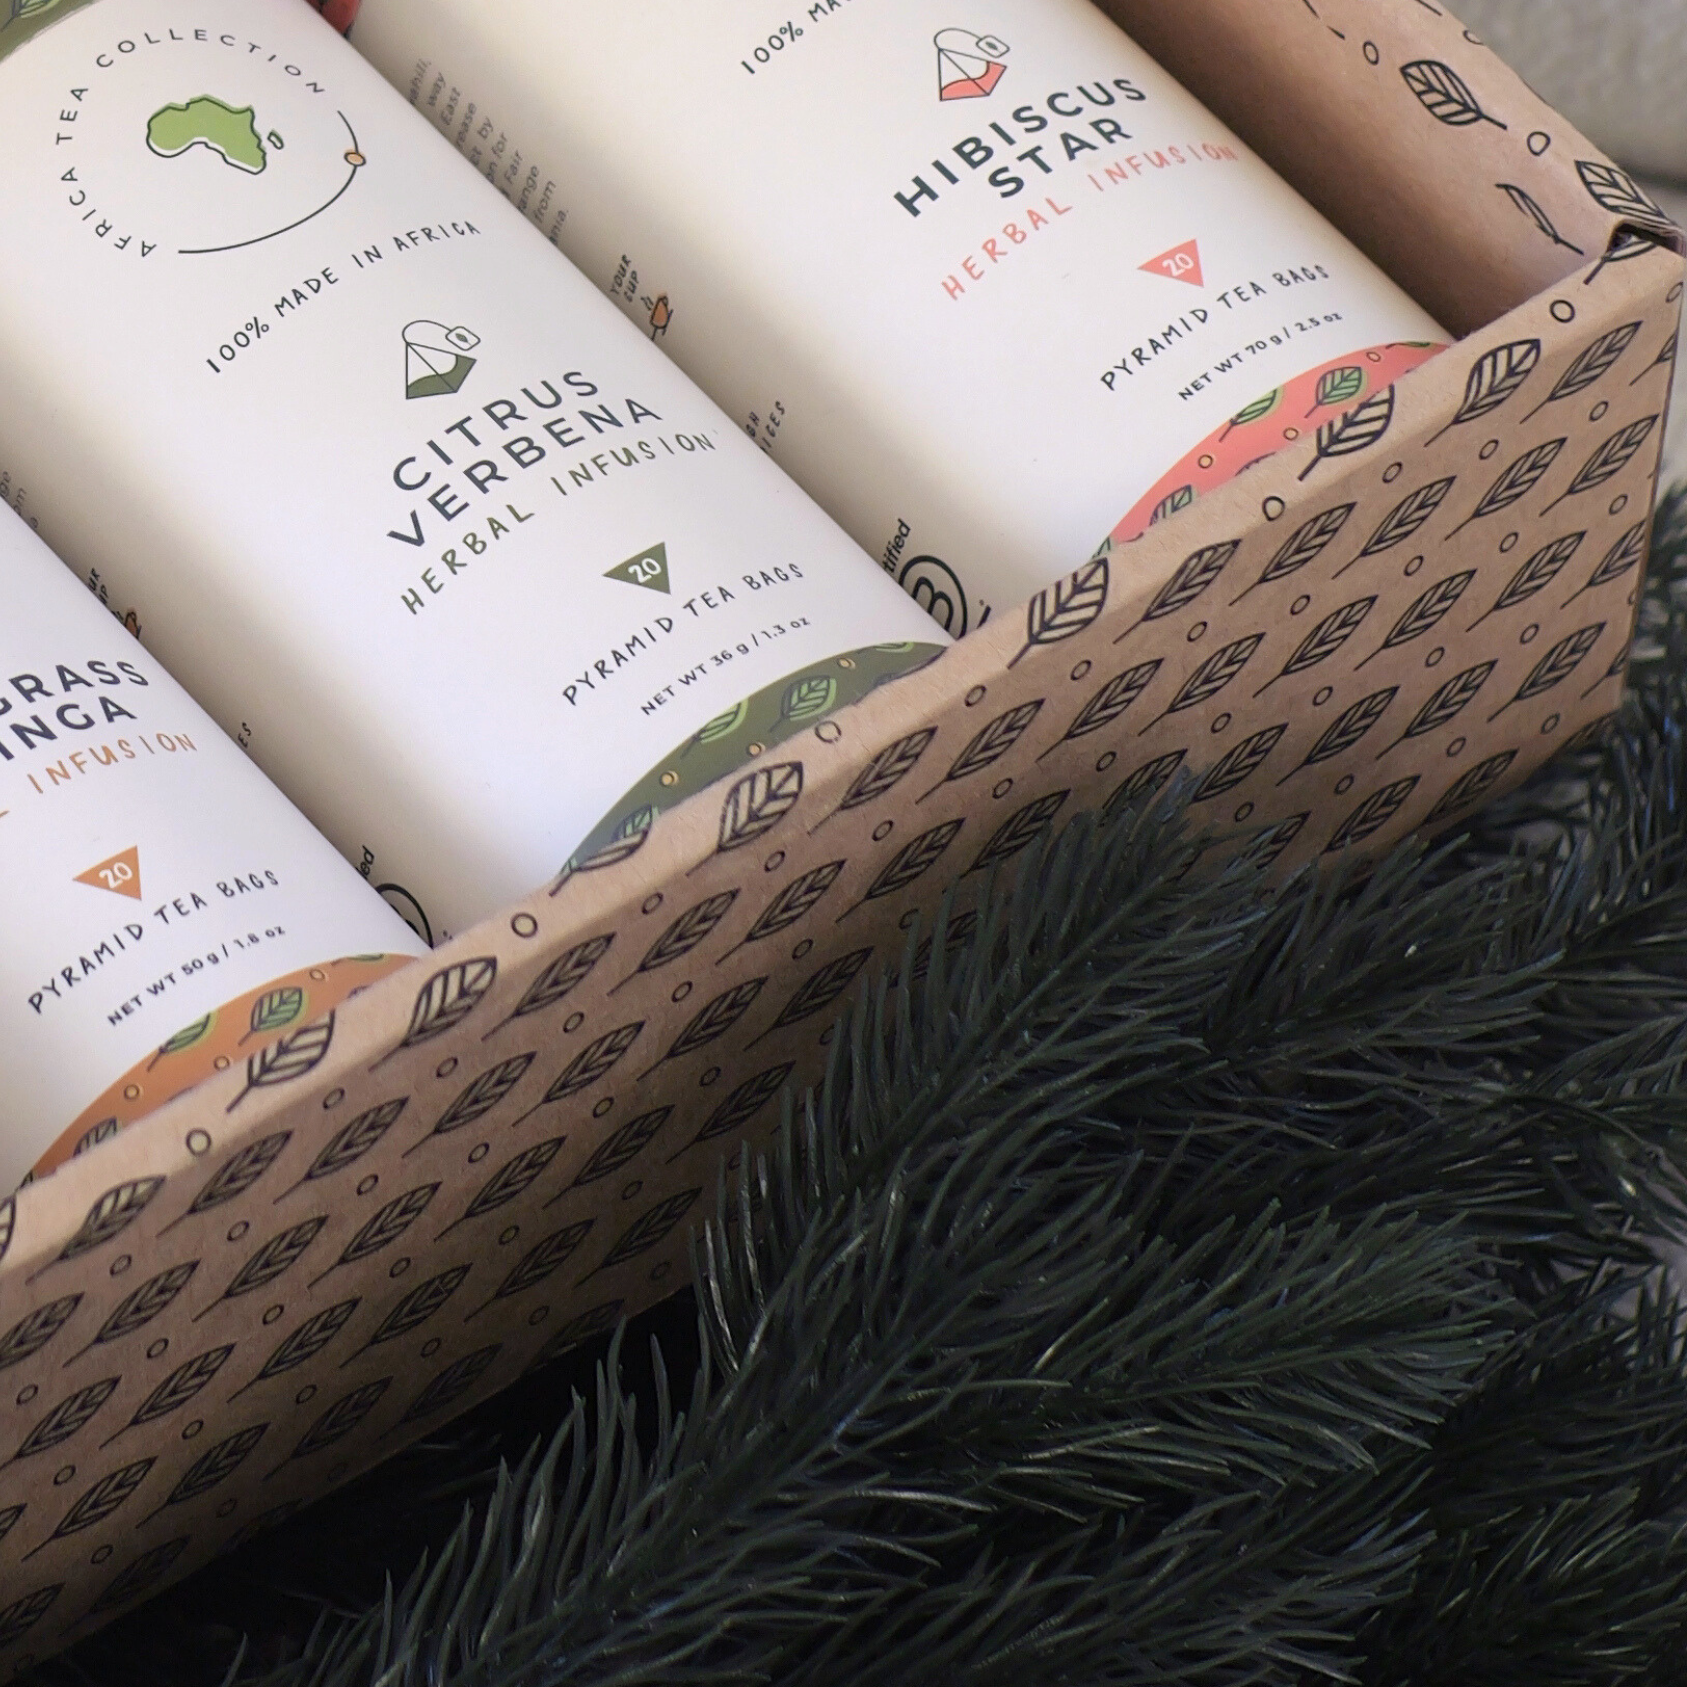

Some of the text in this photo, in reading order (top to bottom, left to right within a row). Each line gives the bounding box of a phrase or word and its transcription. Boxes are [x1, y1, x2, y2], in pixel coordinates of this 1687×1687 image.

[740, 20, 804, 75] 100%
[56, 29, 325, 258] AFRICA TEA COLLECTION
[441, 87, 461, 126] East
[477, 116, 494, 140] by
[492, 132, 508, 159] for
[893, 77, 1146, 217] HIBISCUS
[504, 150, 523, 185] Fair
[988, 117, 1132, 199] STAR
[533, 180, 556, 224] from
[941, 142, 1238, 301] HERBAL INFUSION
[206, 220, 481, 373] 100% MADE IN AFRICA
[610, 255, 632, 295] YOUR
[624, 270, 640, 303] CUP
[1162, 253, 1194, 276] 20
[1100, 263, 1330, 392] PYRAMID TEA BAGS
[1179, 373, 1212, 401] NET
[1214, 352, 1243, 374] WT
[1245, 339, 1268, 354] 70
[1270, 332, 1282, 346] g
[1294, 317, 1320, 332] 2.5
[1324, 312, 1343, 322] oz
[387, 398, 662, 548] VERBENA
[392, 370, 598, 492] CITRUS
[401, 430, 715, 615] HERBAL INFUSION
[628, 557, 662, 583] 20
[562, 562, 803, 706] PYRAMID TEA BAGS
[640, 686, 674, 716] NET
[678, 664, 707, 688] WT
[710, 649, 733, 668] 36
[736, 640, 749, 657] g
[762, 623, 787, 640] 1.3
[789, 616, 811, 629] oz
[27, 732, 197, 793] INFUSION
[100, 860, 134, 889] 20
[28, 870, 280, 1013] PYRAMID TEA BAGS
[106, 994, 143, 1026] NET
[150, 969, 177, 994] WT
[182, 959, 205, 977] 50
[208, 951, 219, 966] g
[266, 925, 285, 937] oz
